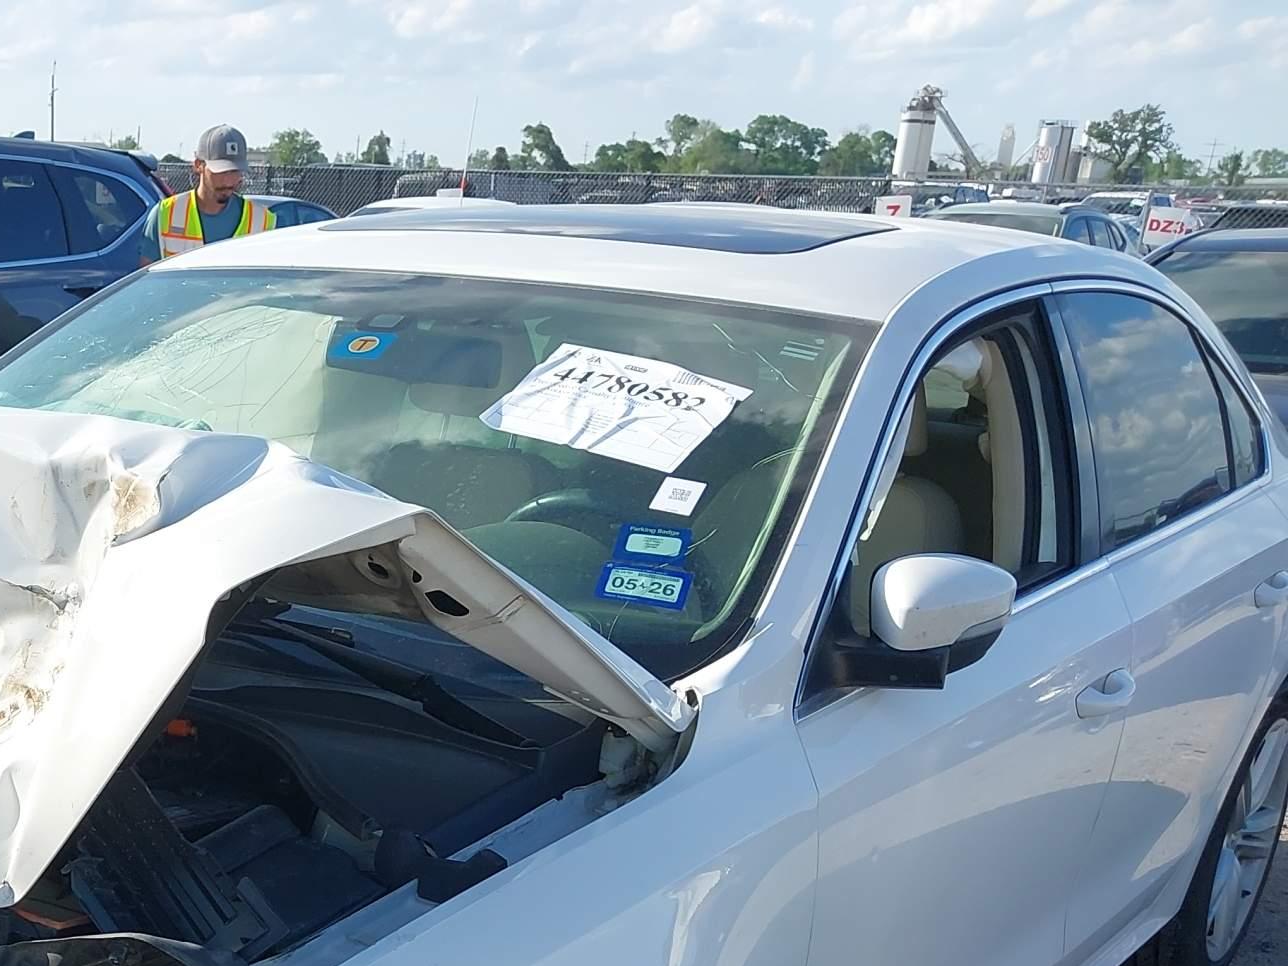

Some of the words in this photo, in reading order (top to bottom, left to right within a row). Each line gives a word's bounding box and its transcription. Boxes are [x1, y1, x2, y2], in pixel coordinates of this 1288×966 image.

[553, 367, 706, 411] 44780582
[629, 525, 657, 535] Parking
[657, 527, 680, 537] Badge
[611, 575, 639, 591] 05
[648, 581, 677, 597] 26
